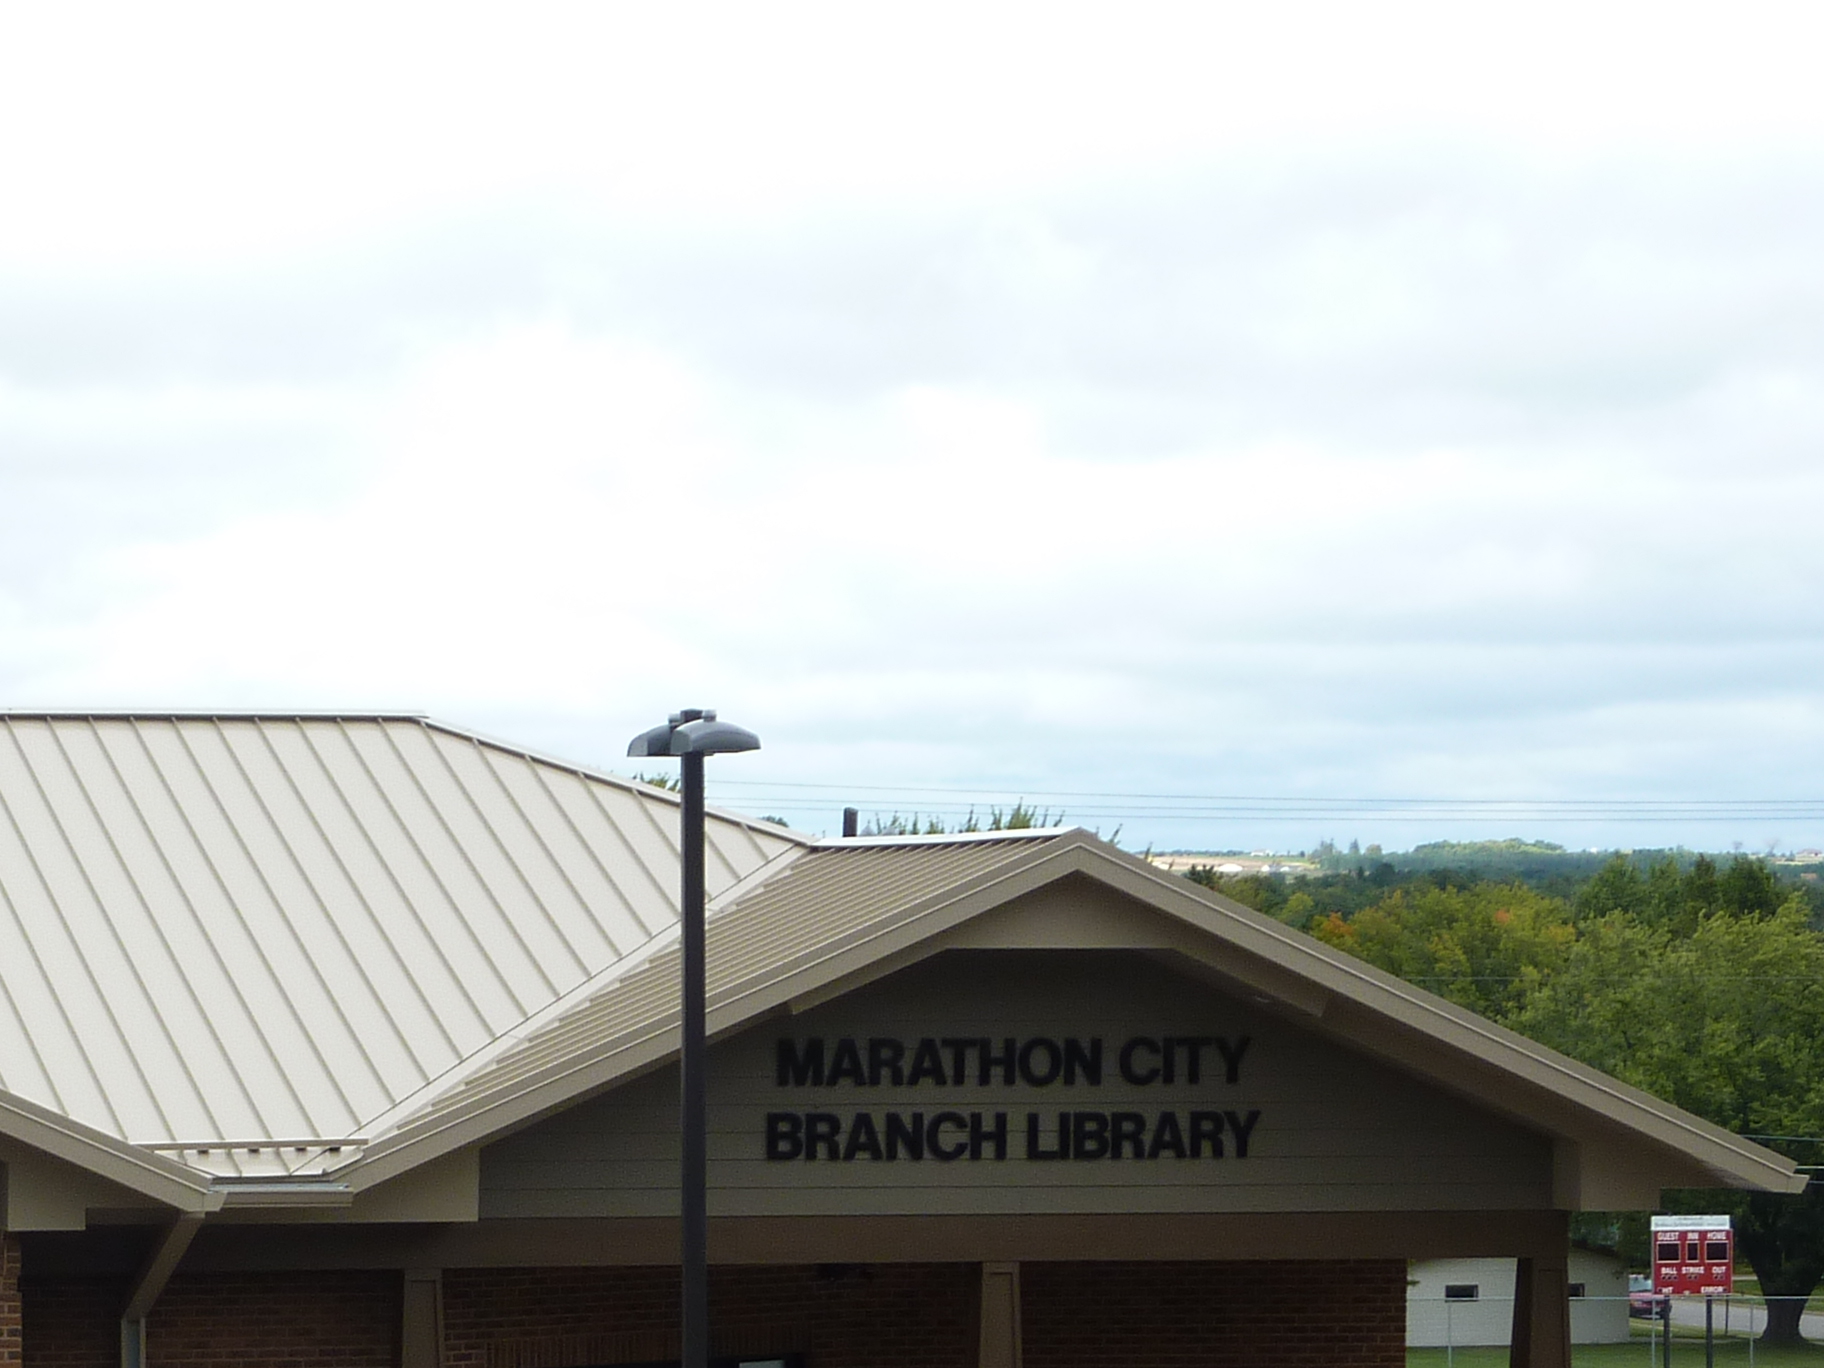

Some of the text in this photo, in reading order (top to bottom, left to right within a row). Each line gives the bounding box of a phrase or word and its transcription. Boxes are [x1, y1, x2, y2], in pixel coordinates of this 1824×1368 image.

[777, 1036, 1251, 1087] MARATHON CITY
[766, 1110, 1260, 1161] BRANCH LIBRARY
